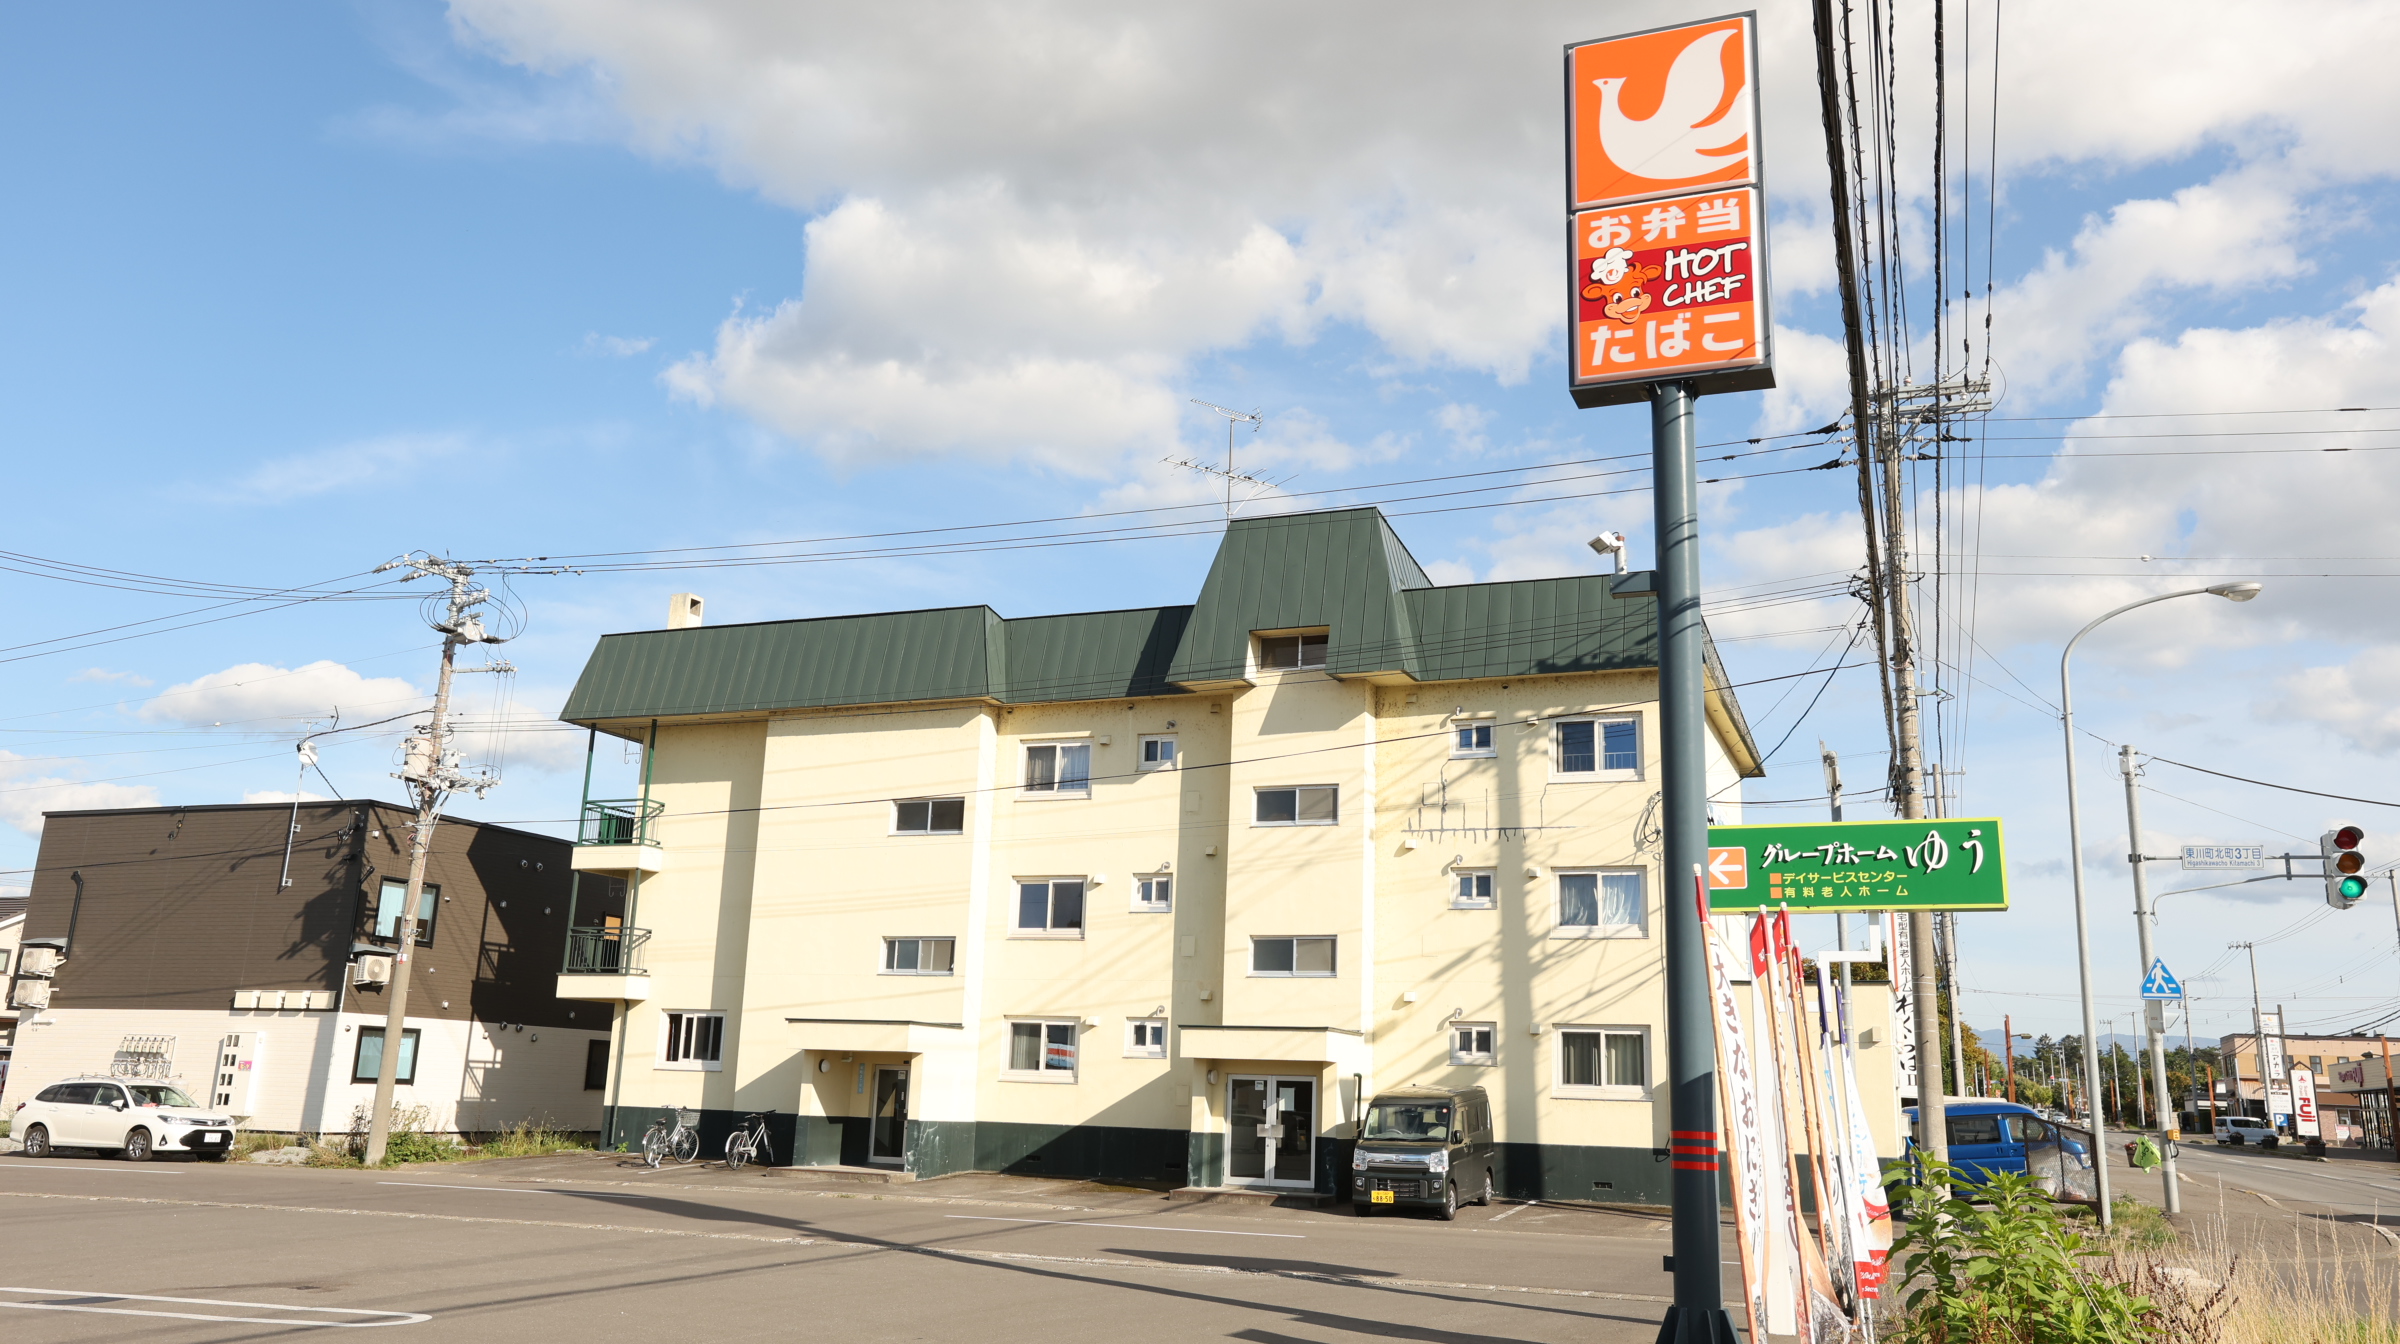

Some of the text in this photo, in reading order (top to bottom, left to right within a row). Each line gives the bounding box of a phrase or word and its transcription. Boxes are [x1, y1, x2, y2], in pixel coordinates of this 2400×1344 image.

[1587, 197, 1741, 249] お弁当
[1664, 241, 1749, 282] HOT
[1661, 273, 1746, 308] CHEF
[1591, 310, 1745, 367] たばこ
[1761, 828, 1984, 874] グループホーム ゆう
[2185, 847, 2262, 860] 東川町北町3丁目
[1783, 871, 1908, 885] デイサービスセンター
[1784, 885, 1909, 899] 有料老人ホーム
[2275, 1114, 2285, 1126] P
